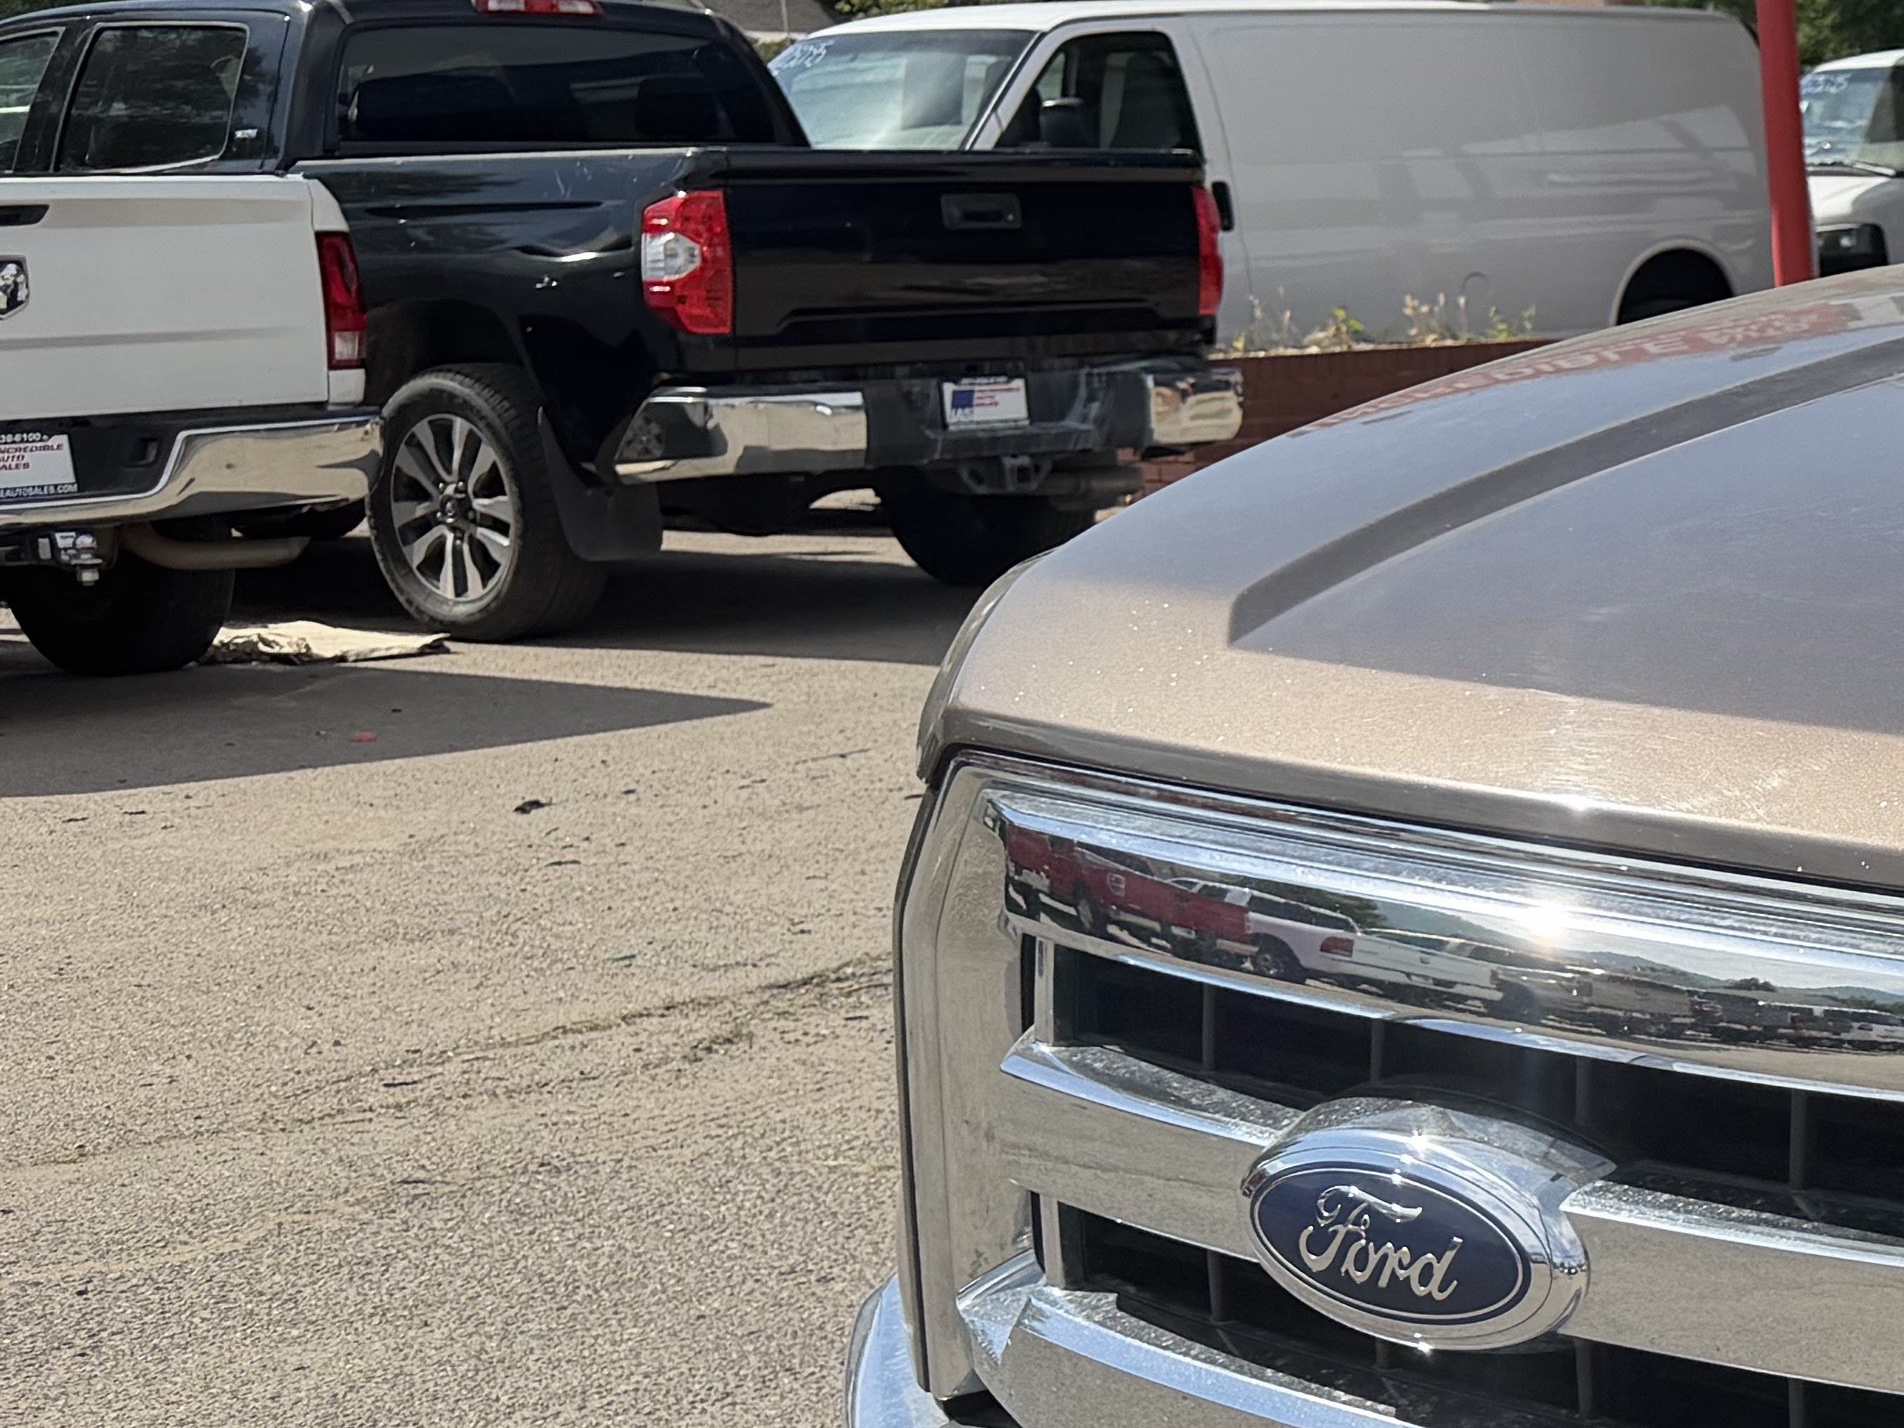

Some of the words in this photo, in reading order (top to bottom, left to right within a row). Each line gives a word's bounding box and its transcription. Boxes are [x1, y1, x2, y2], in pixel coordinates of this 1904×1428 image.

[0, 443, 64, 454] NCREDIBLE
[0, 462, 30, 471] ALES
[1299, 1185, 1463, 1301] Ford
